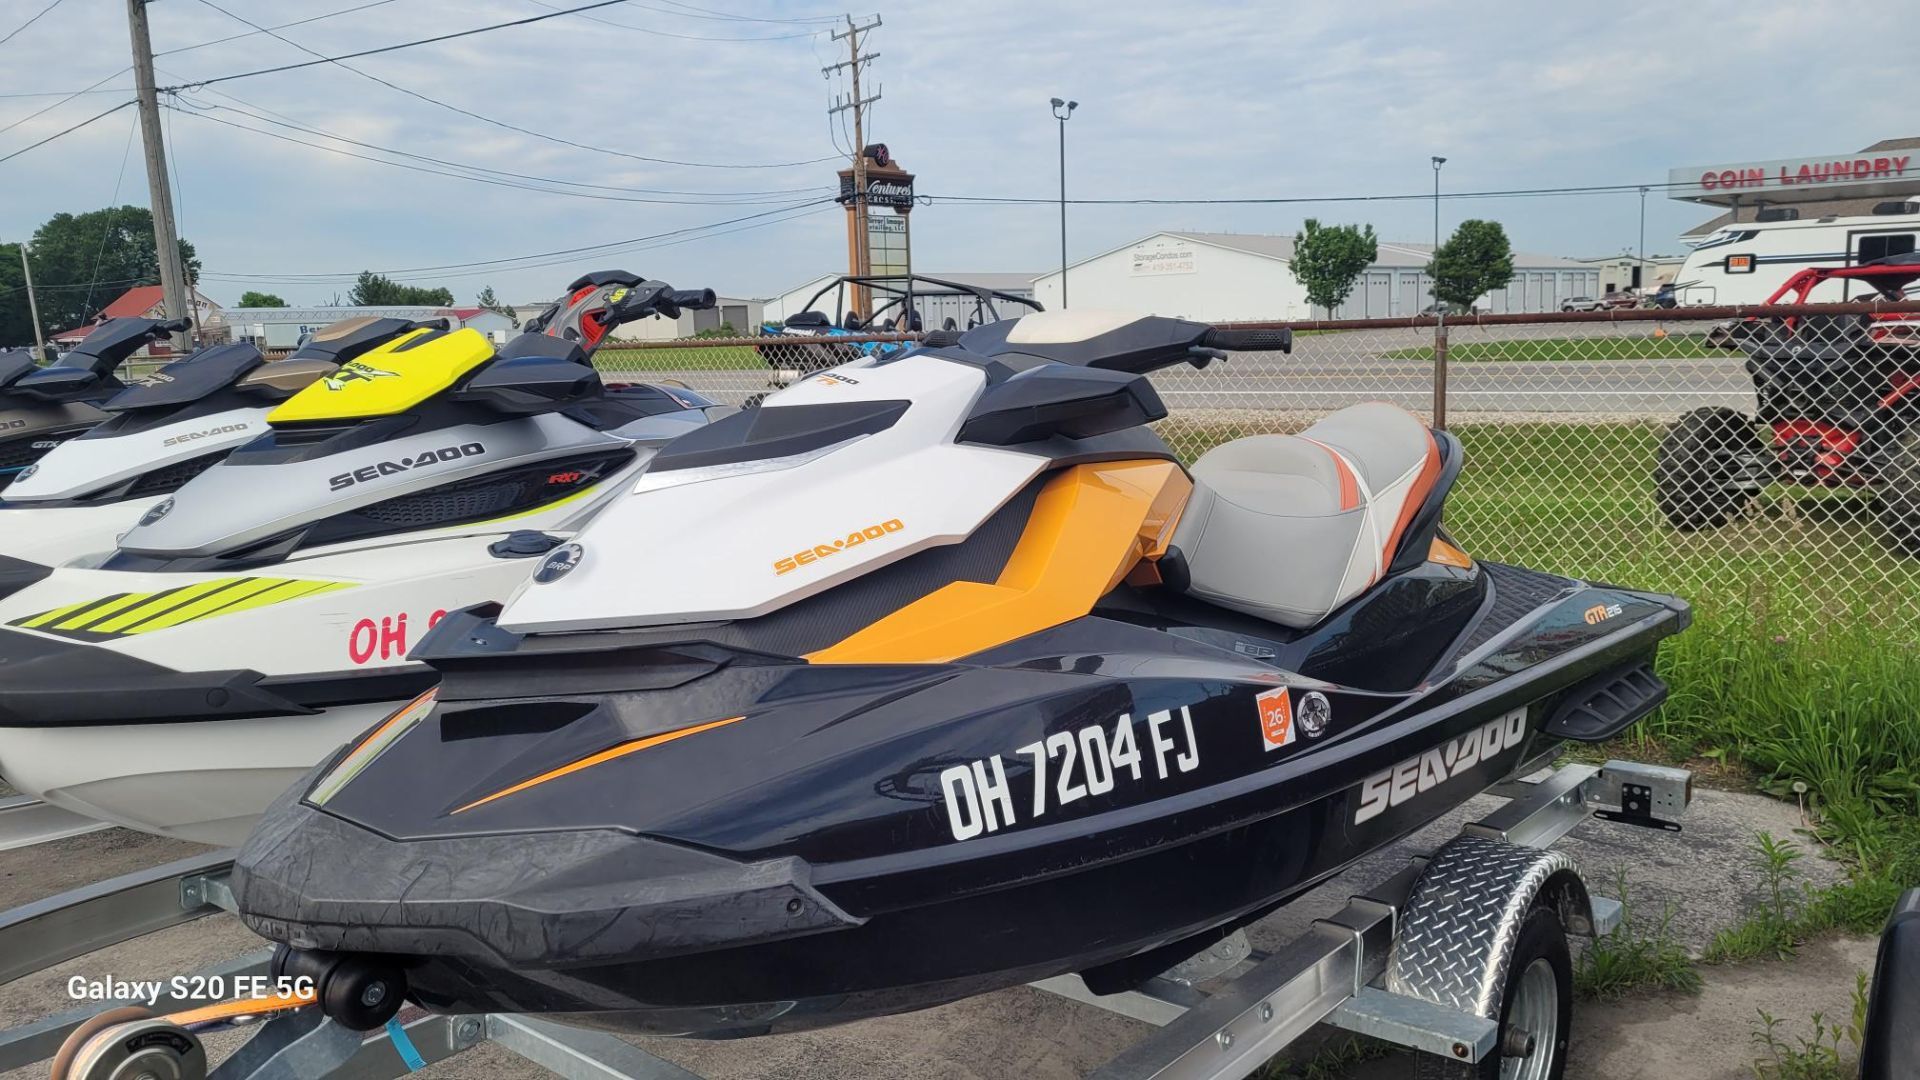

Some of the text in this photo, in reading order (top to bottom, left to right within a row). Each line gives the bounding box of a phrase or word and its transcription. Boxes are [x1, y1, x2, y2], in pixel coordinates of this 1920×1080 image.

[1701, 156, 1910, 191] COIN LAUNDRY
[350, 612, 408, 665] OH
[1267, 707, 1284, 728] 26
[940, 705, 1200, 841] OH 7204 FJ
